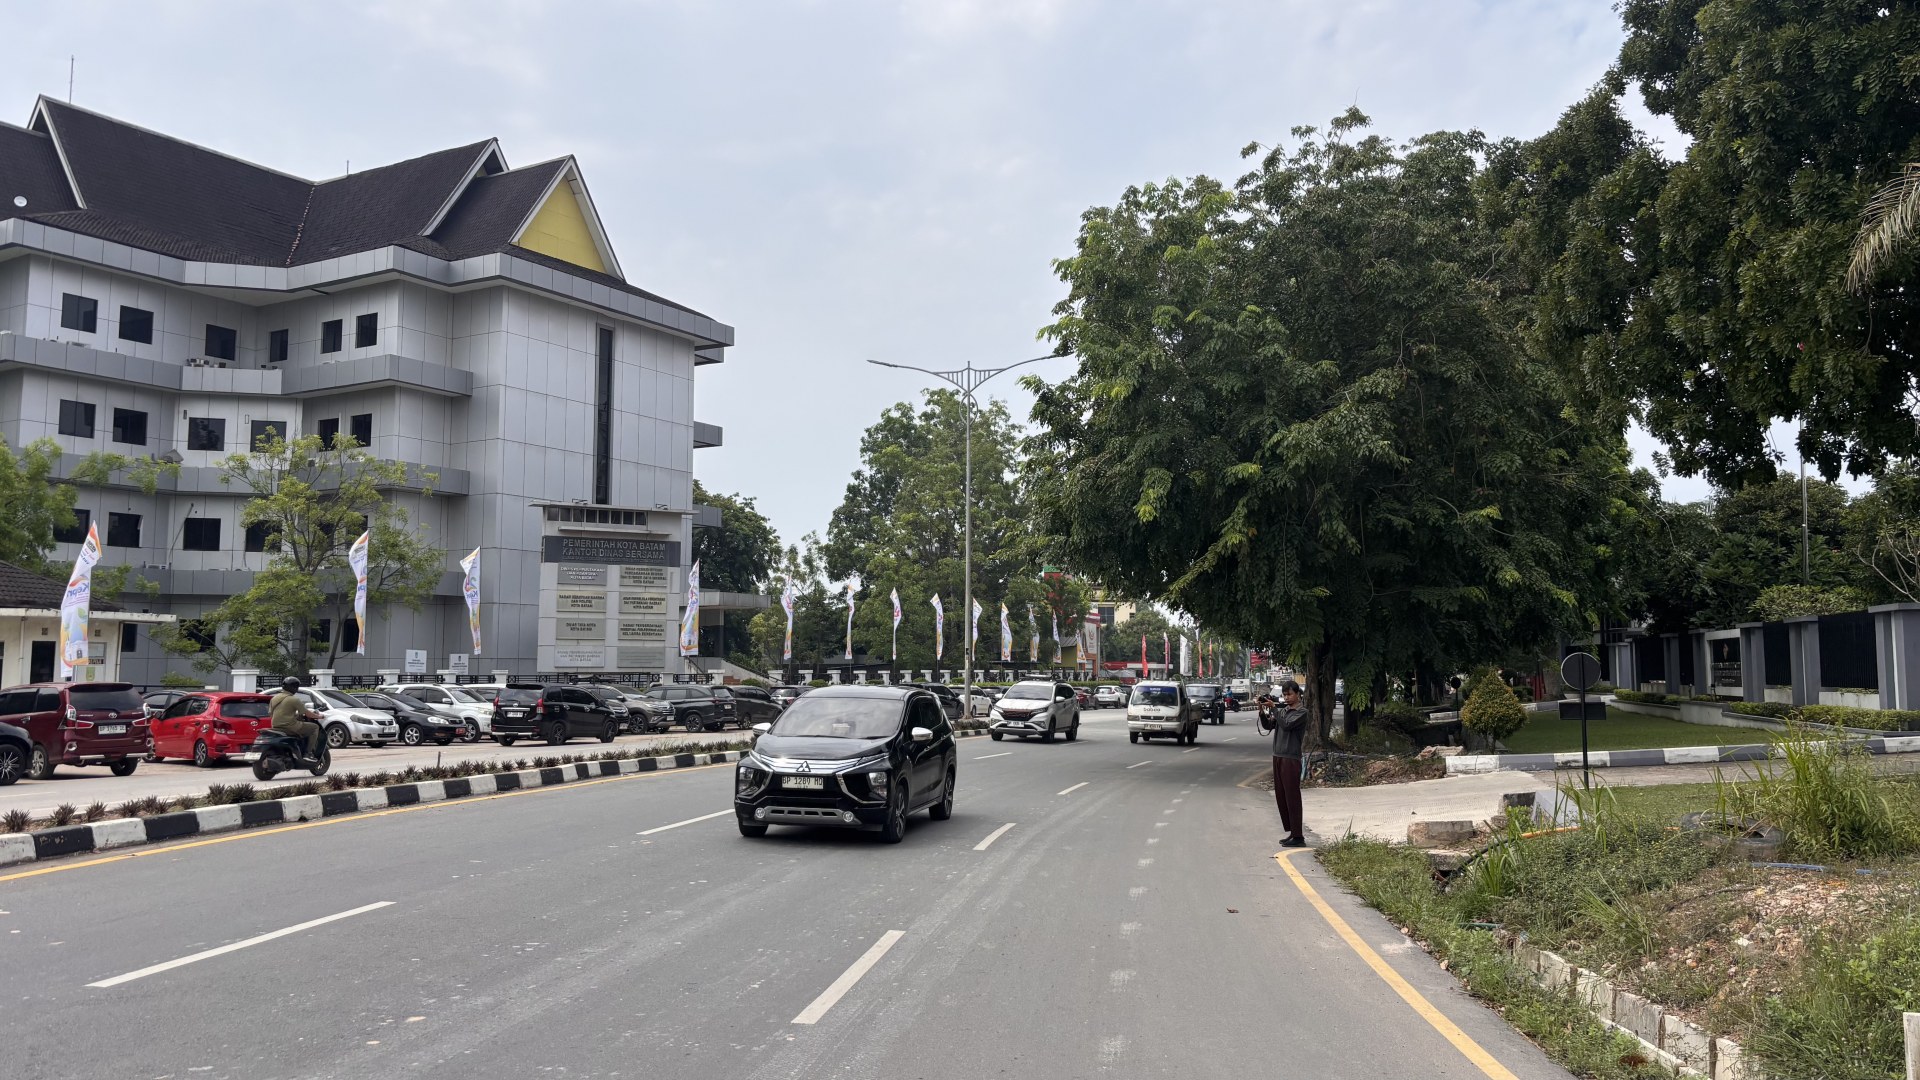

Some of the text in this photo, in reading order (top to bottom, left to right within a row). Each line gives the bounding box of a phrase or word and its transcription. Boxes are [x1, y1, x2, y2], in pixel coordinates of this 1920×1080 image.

[563, 538, 666, 551] PEMERINTAH KOTA BATAM
[562, 547, 665, 559] KANTOR DINAS BERSAMA
[782, 776, 791, 784] BP
